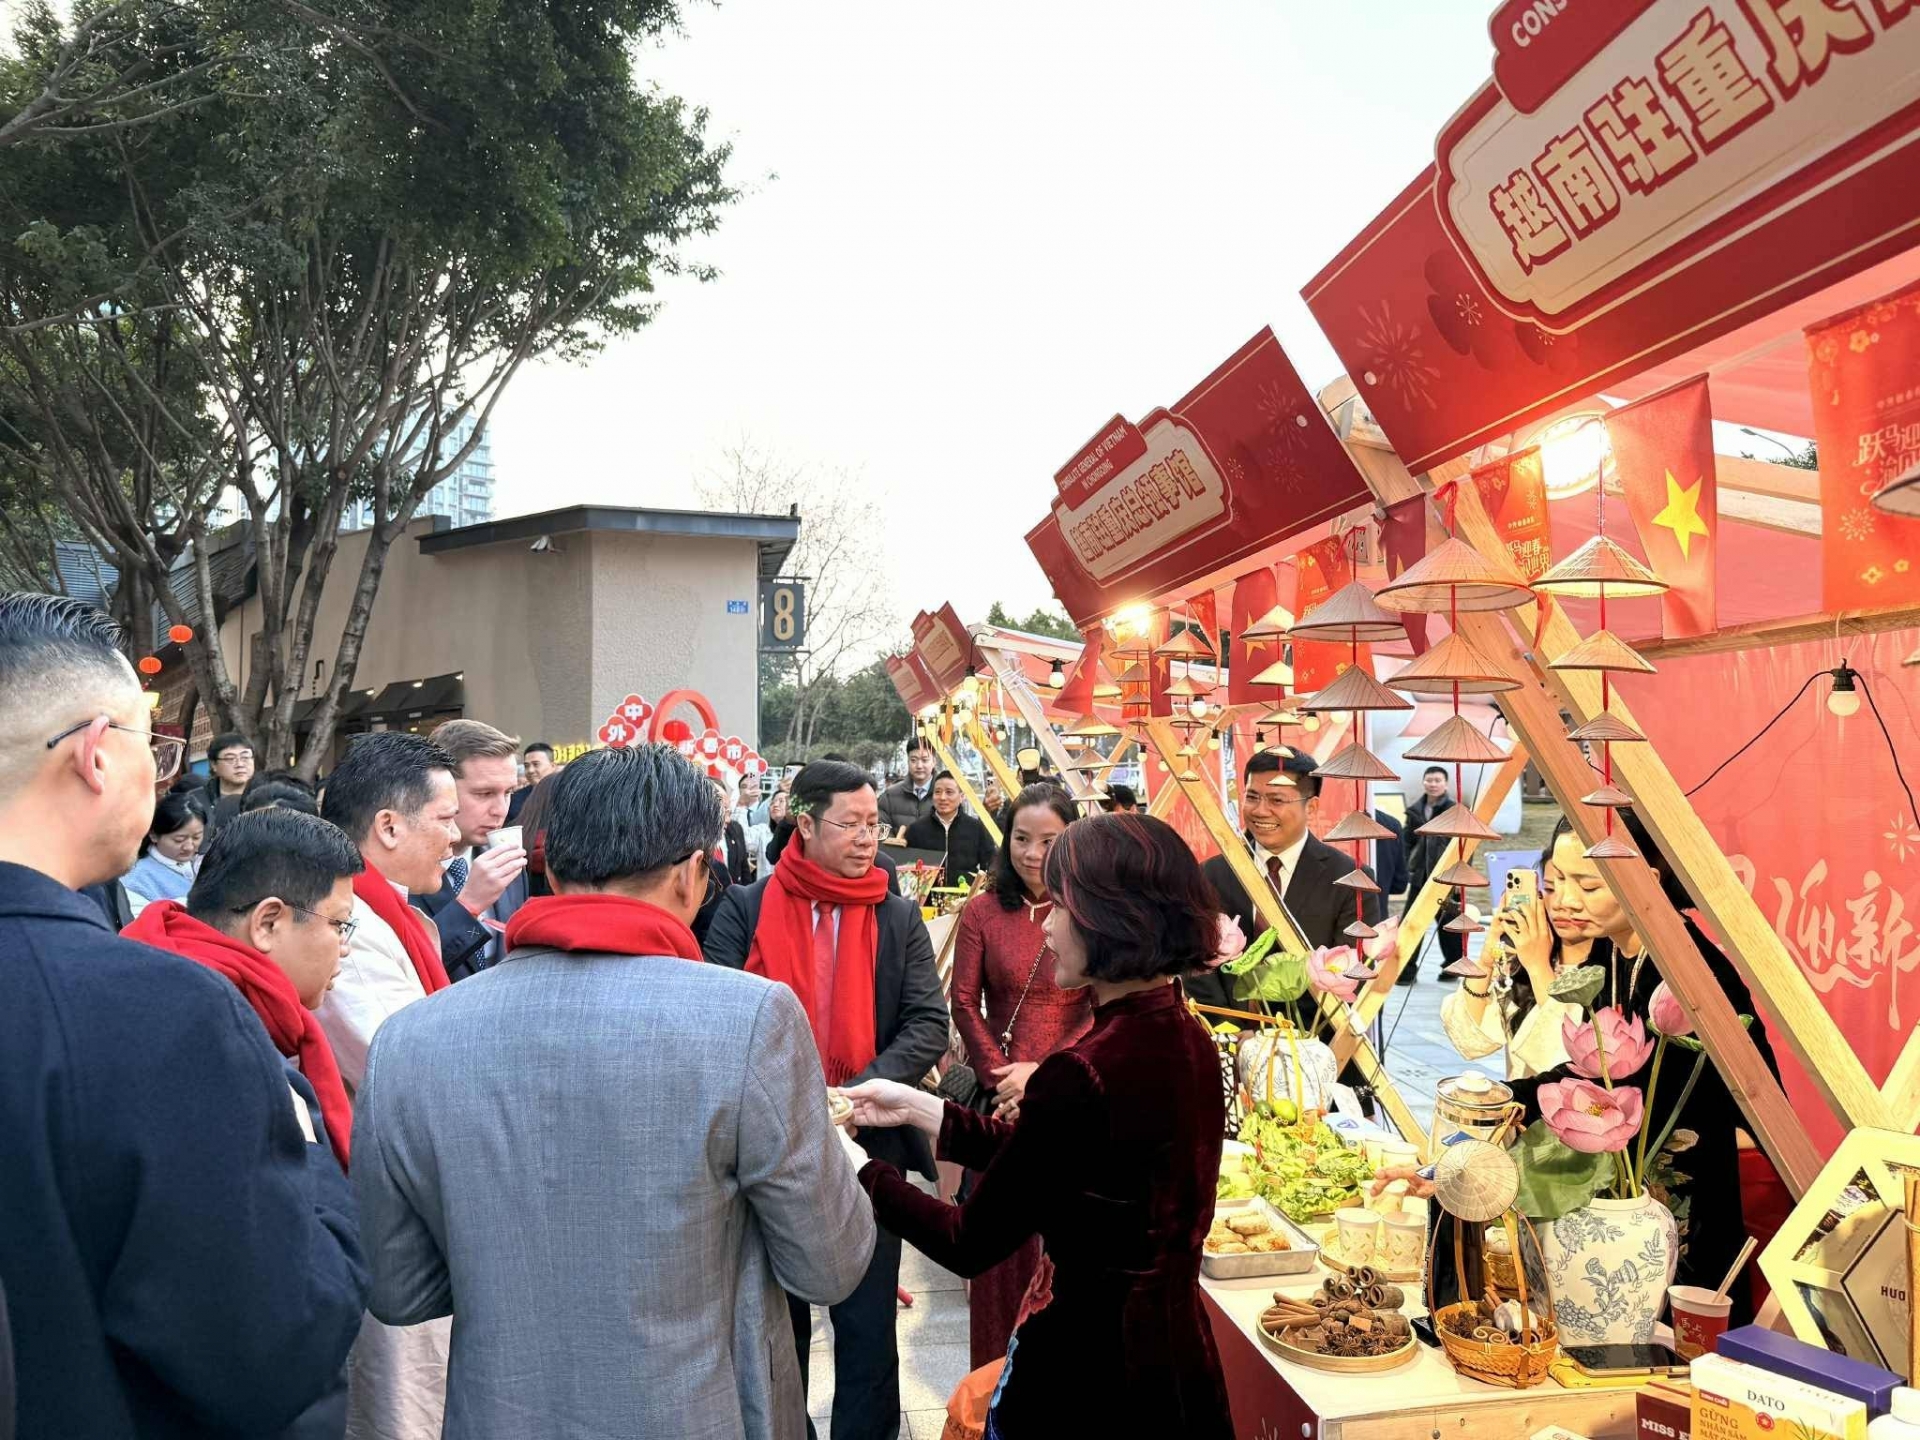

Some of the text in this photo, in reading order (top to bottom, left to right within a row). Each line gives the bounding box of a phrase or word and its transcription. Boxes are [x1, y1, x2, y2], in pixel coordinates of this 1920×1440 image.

[1489, 0, 1911, 276] 越南驻重庆
[1078, 450, 1099, 474] GENERAL
[1095, 444, 1105, 458] OF
[1101, 424, 1128, 452] VIETNAM
[1069, 449, 1206, 563] 越南驻重庆总领事馆
[773, 588, 795, 641] 8
[1727, 854, 1920, 1031] 迎新
[1747, 1389, 1785, 1411] DATO
[1641, 1418, 1691, 1440] MISS E
